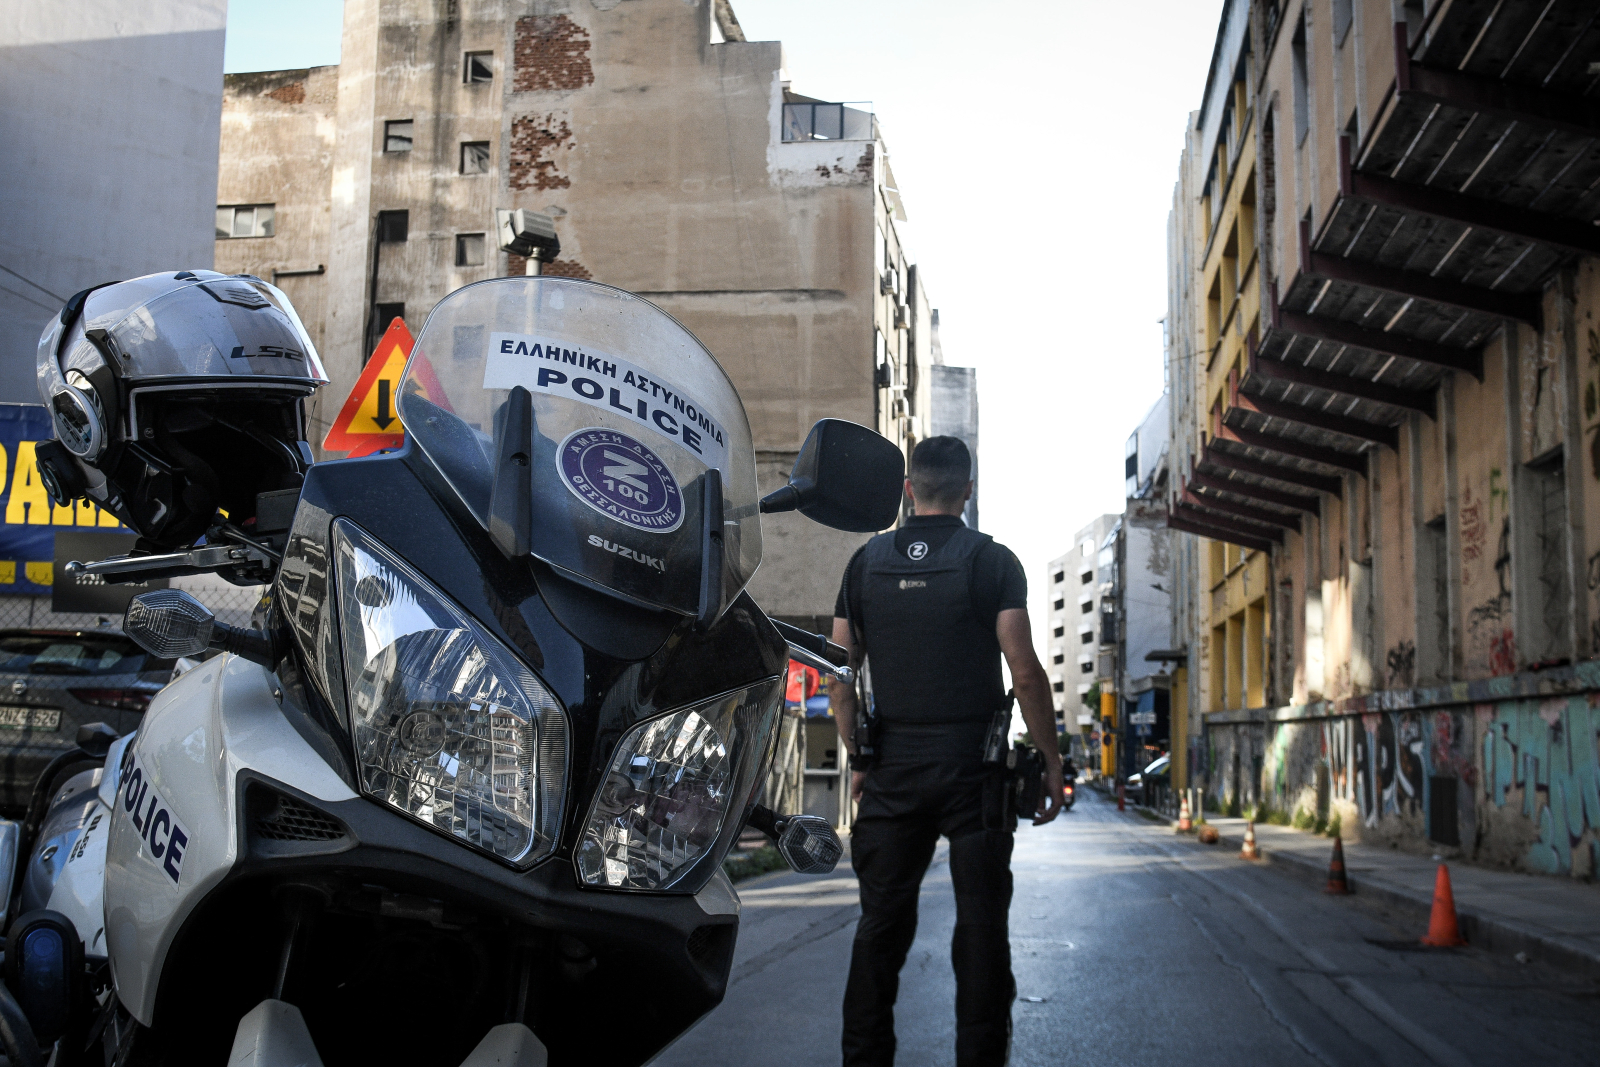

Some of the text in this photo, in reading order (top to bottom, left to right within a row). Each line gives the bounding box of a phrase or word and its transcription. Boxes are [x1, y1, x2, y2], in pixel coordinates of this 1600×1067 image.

[231, 346, 304, 362] LS2
[500, 339, 724, 448] ΕΛΛΗΝΙΚΗ ΑΣΤΥΝΟΜΙΑ
[537, 367, 703, 455] POLICE
[570, 433, 676, 494] ΑΜΕΣΗ ΔΡΑΣΗ
[572, 475, 676, 526] ΘΕΣΣΑΛΟΝΙΚΗΣ
[602, 479, 649, 505] 100
[587, 534, 666, 572] SUZUKI
[122, 752, 189, 884] POLICE
